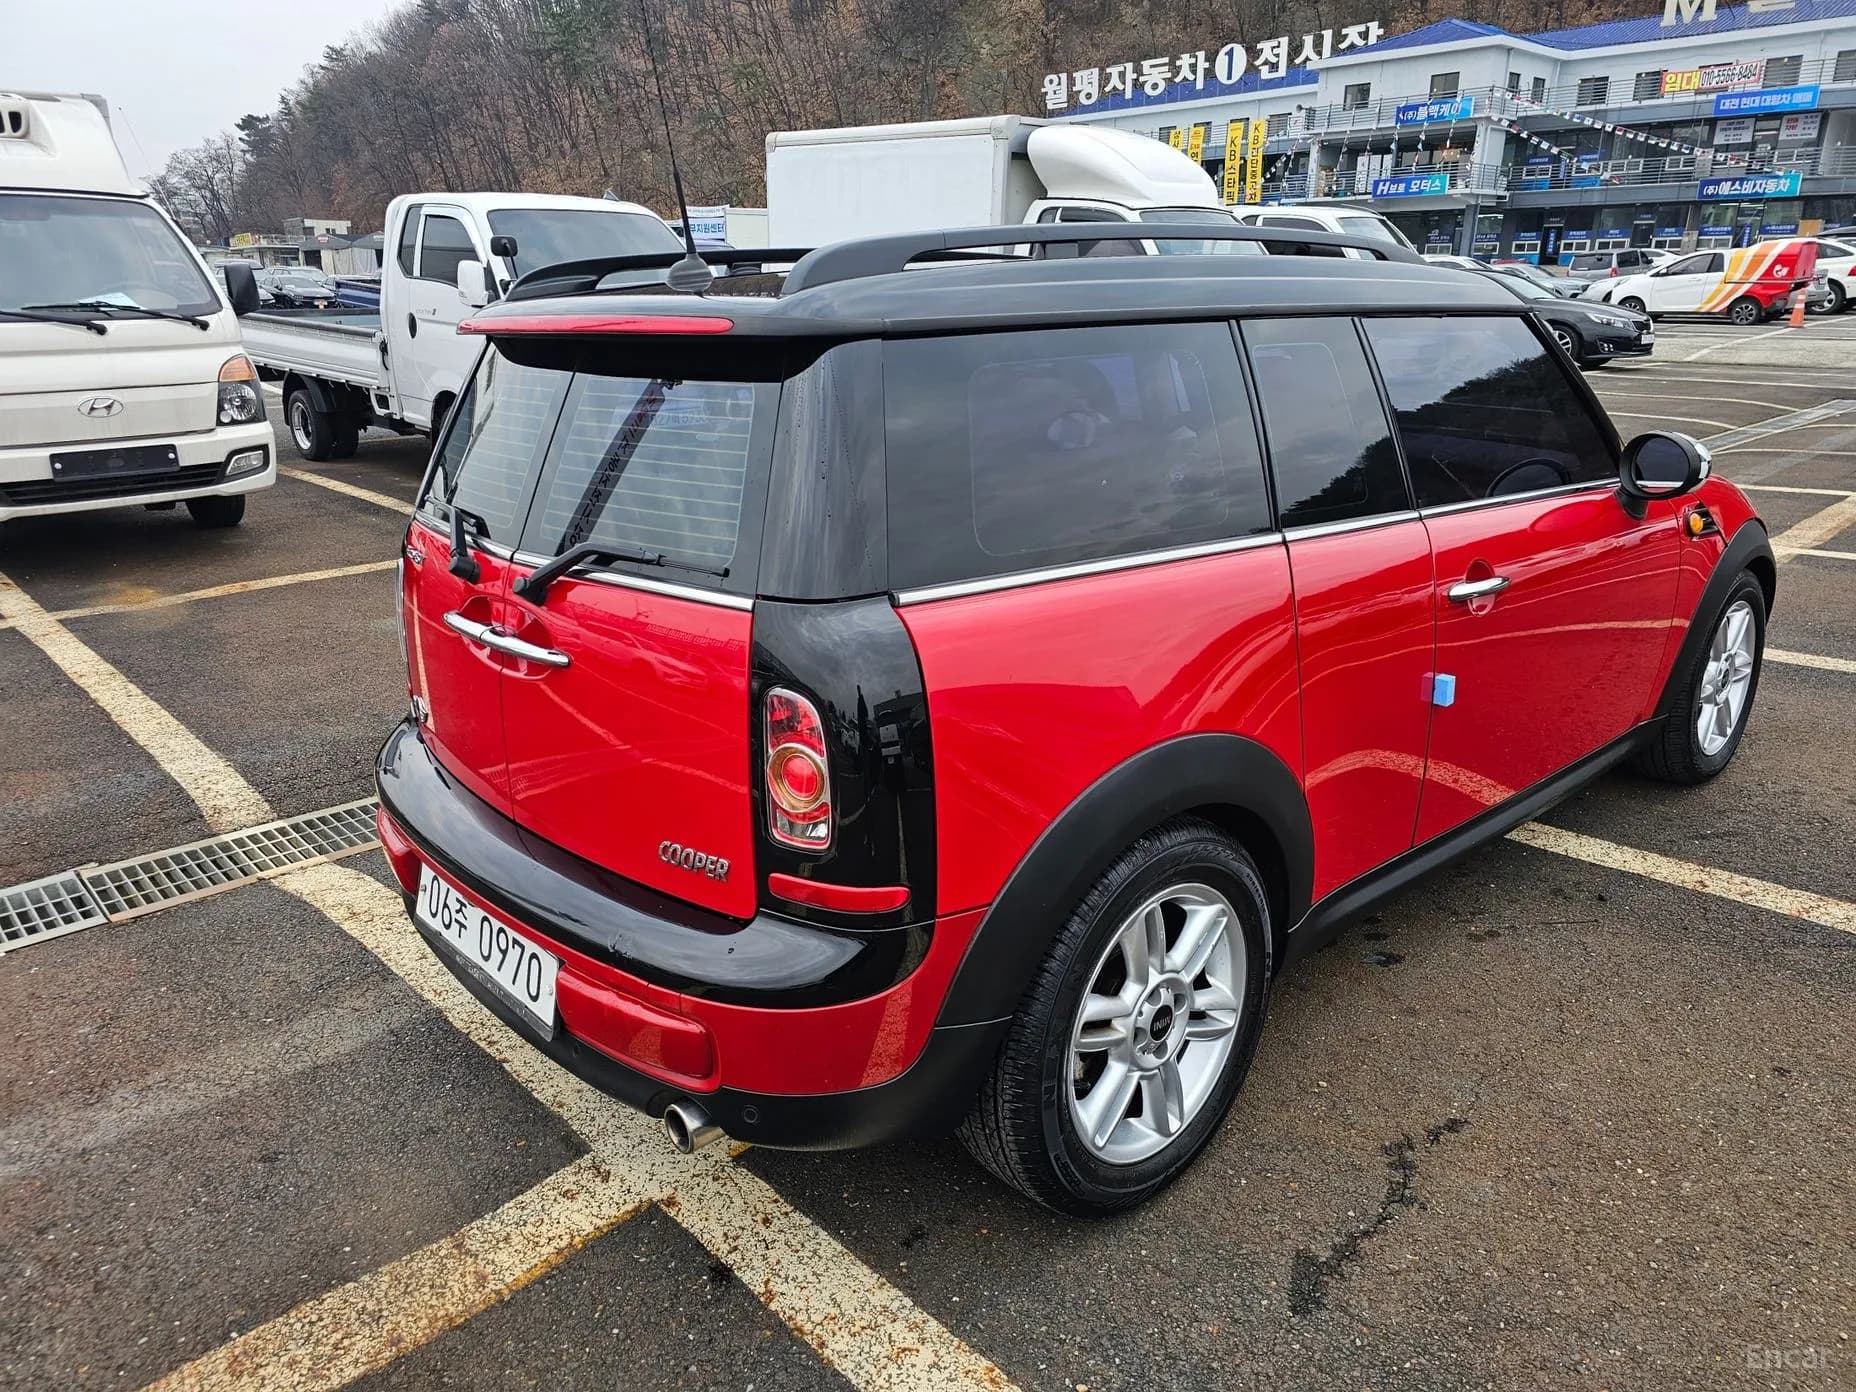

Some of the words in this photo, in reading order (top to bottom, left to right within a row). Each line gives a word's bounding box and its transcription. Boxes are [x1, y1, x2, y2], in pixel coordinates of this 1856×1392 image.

[1664, 71, 1700, 92] 임대
[1408, 179, 1441, 193] 모터스
[1703, 178, 1790, 196] (주)에스비자동차
[658, 839, 729, 882] COOPER
[428, 873, 469, 940] 06주
[478, 914, 543, 1003] 0970
